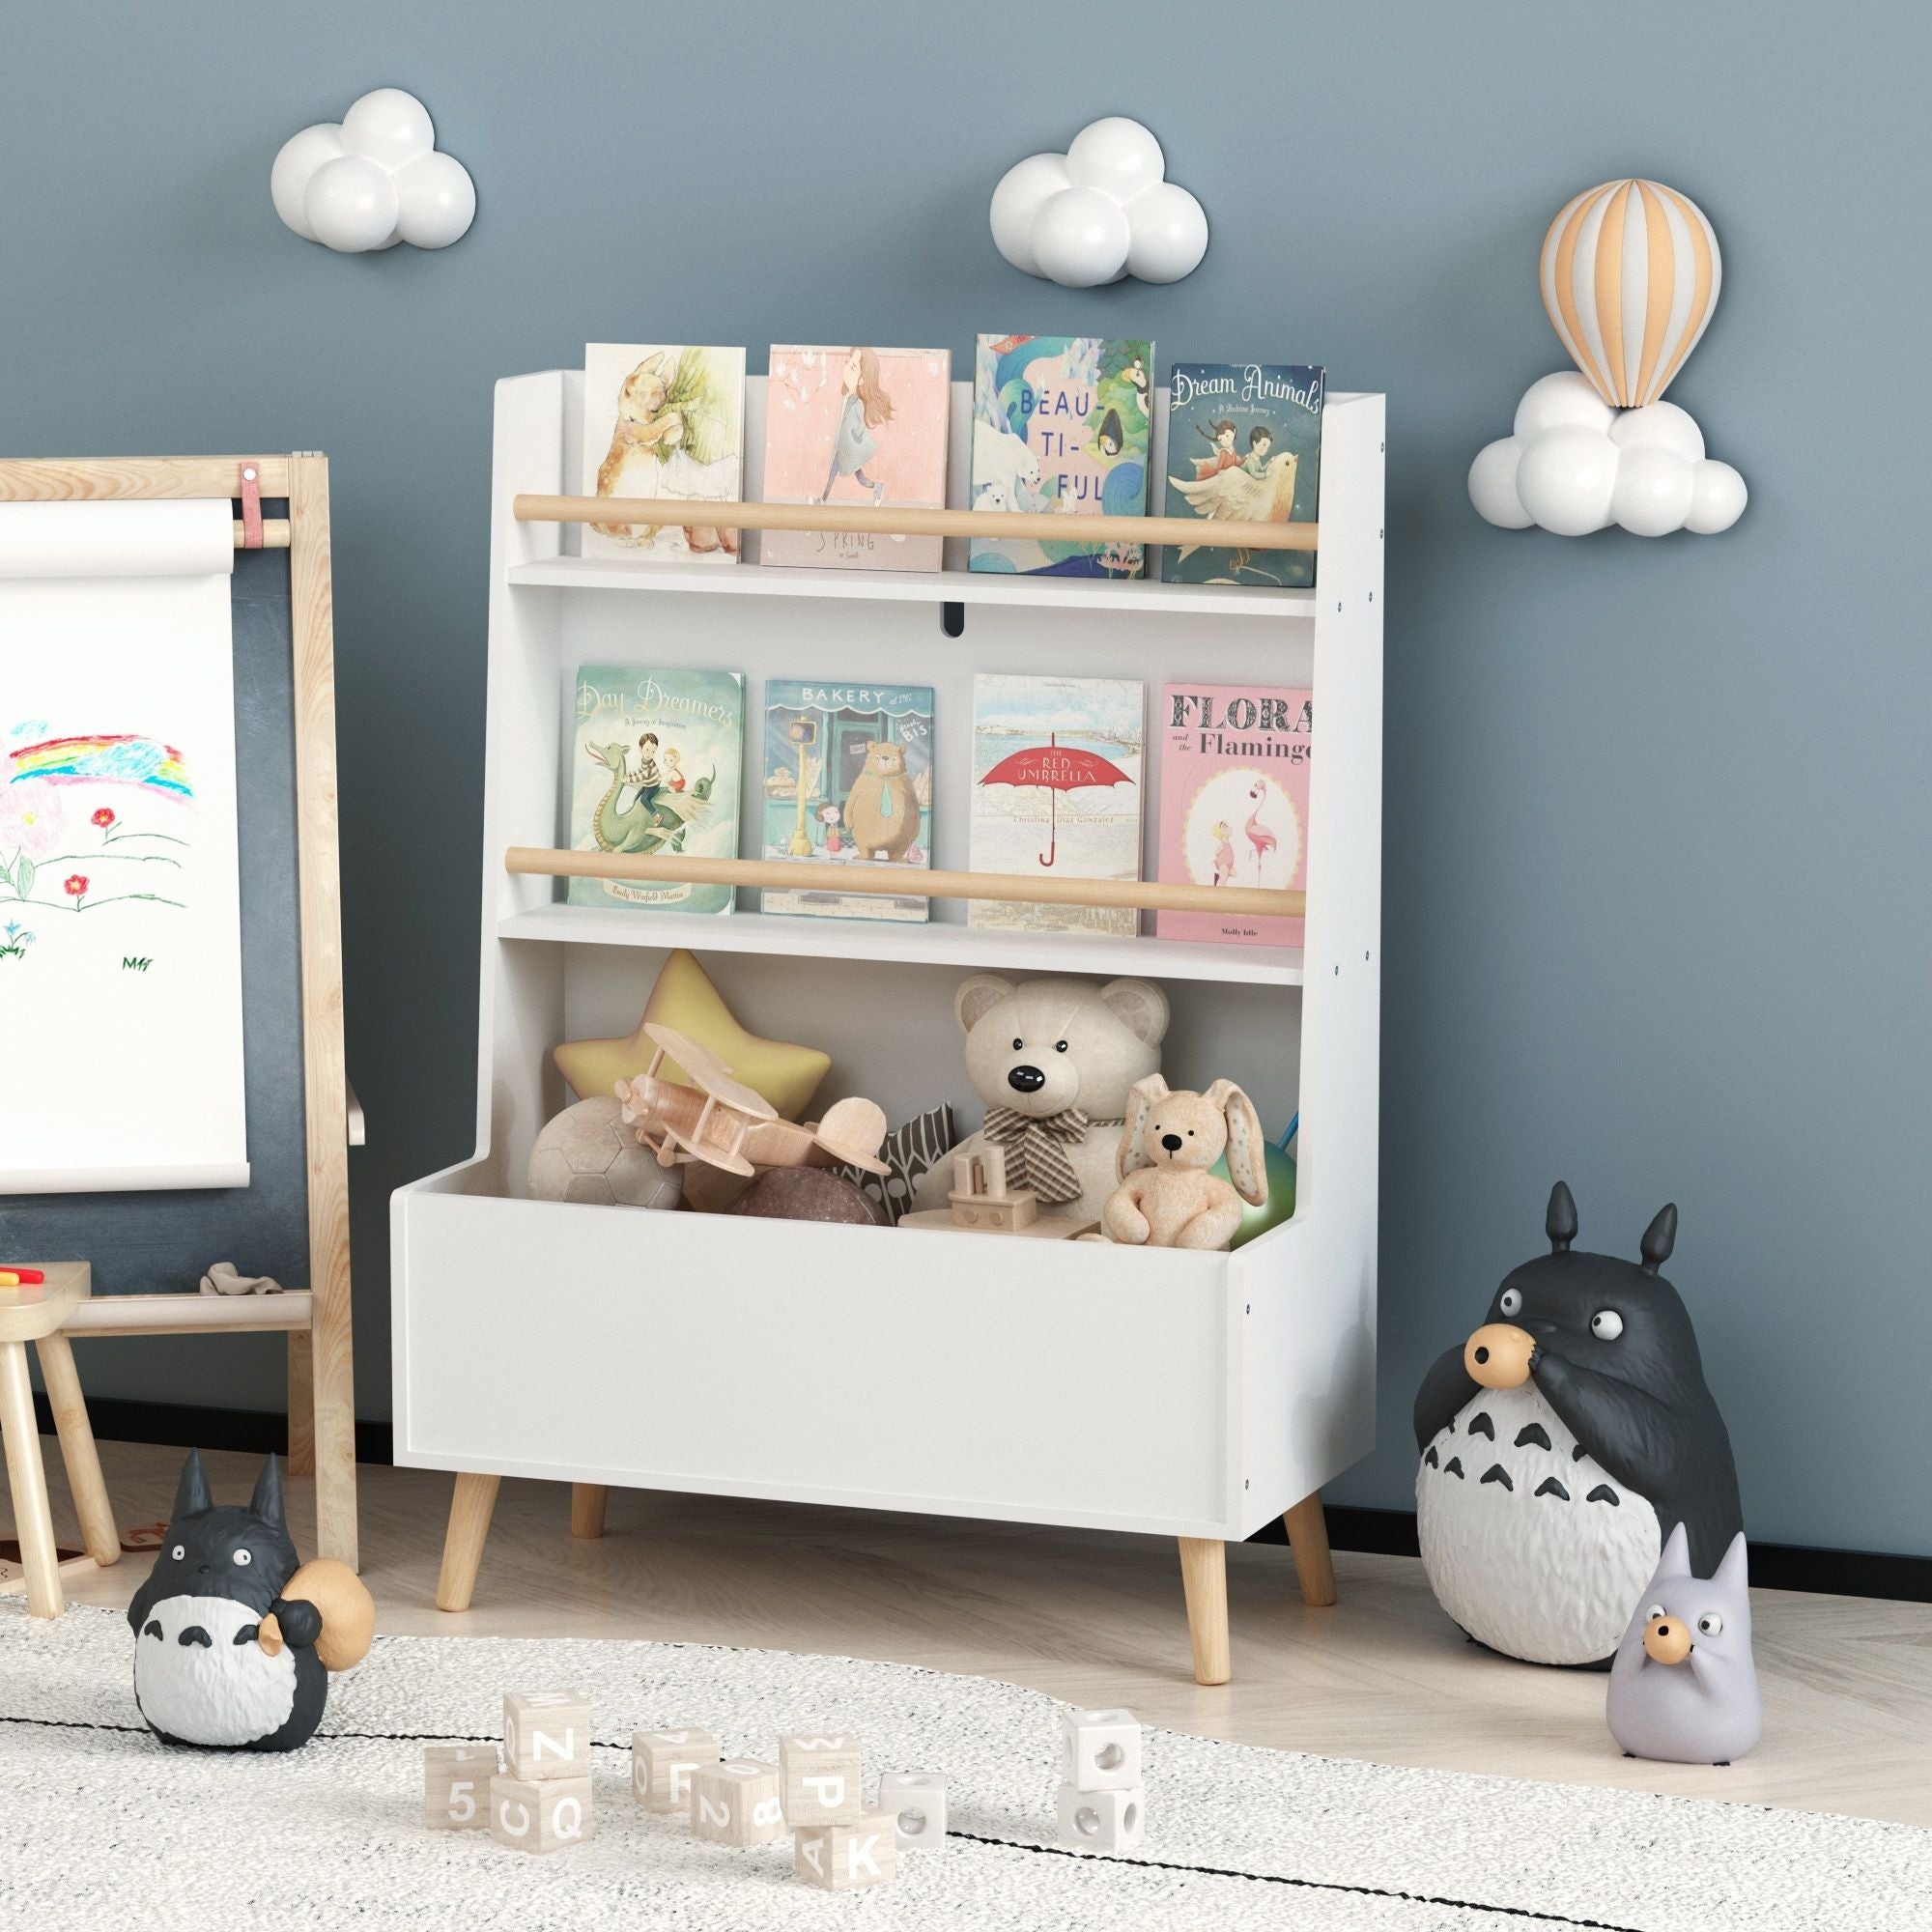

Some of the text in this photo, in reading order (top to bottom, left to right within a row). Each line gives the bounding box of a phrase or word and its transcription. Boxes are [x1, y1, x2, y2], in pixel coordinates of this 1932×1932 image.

[1170, 364, 1320, 414] Dream Animals
[1058, 474, 1102, 500] FUL
[576, 675, 732, 727] Day Dreamers
[802, 688, 884, 704] BAKERY
[1017, 769, 1096, 782] UMBRELLA
[1042, 757, 1070, 770] RED
[1221, 928, 1240, 937] Molly
[448, 1781, 476, 1822] 5
[802, 1776, 845, 1808] P
[552, 1797, 582, 1839] Q
[753, 1797, 782, 1828] 8
[802, 1838, 824, 1879] A
[848, 1834, 882, 1880] K
